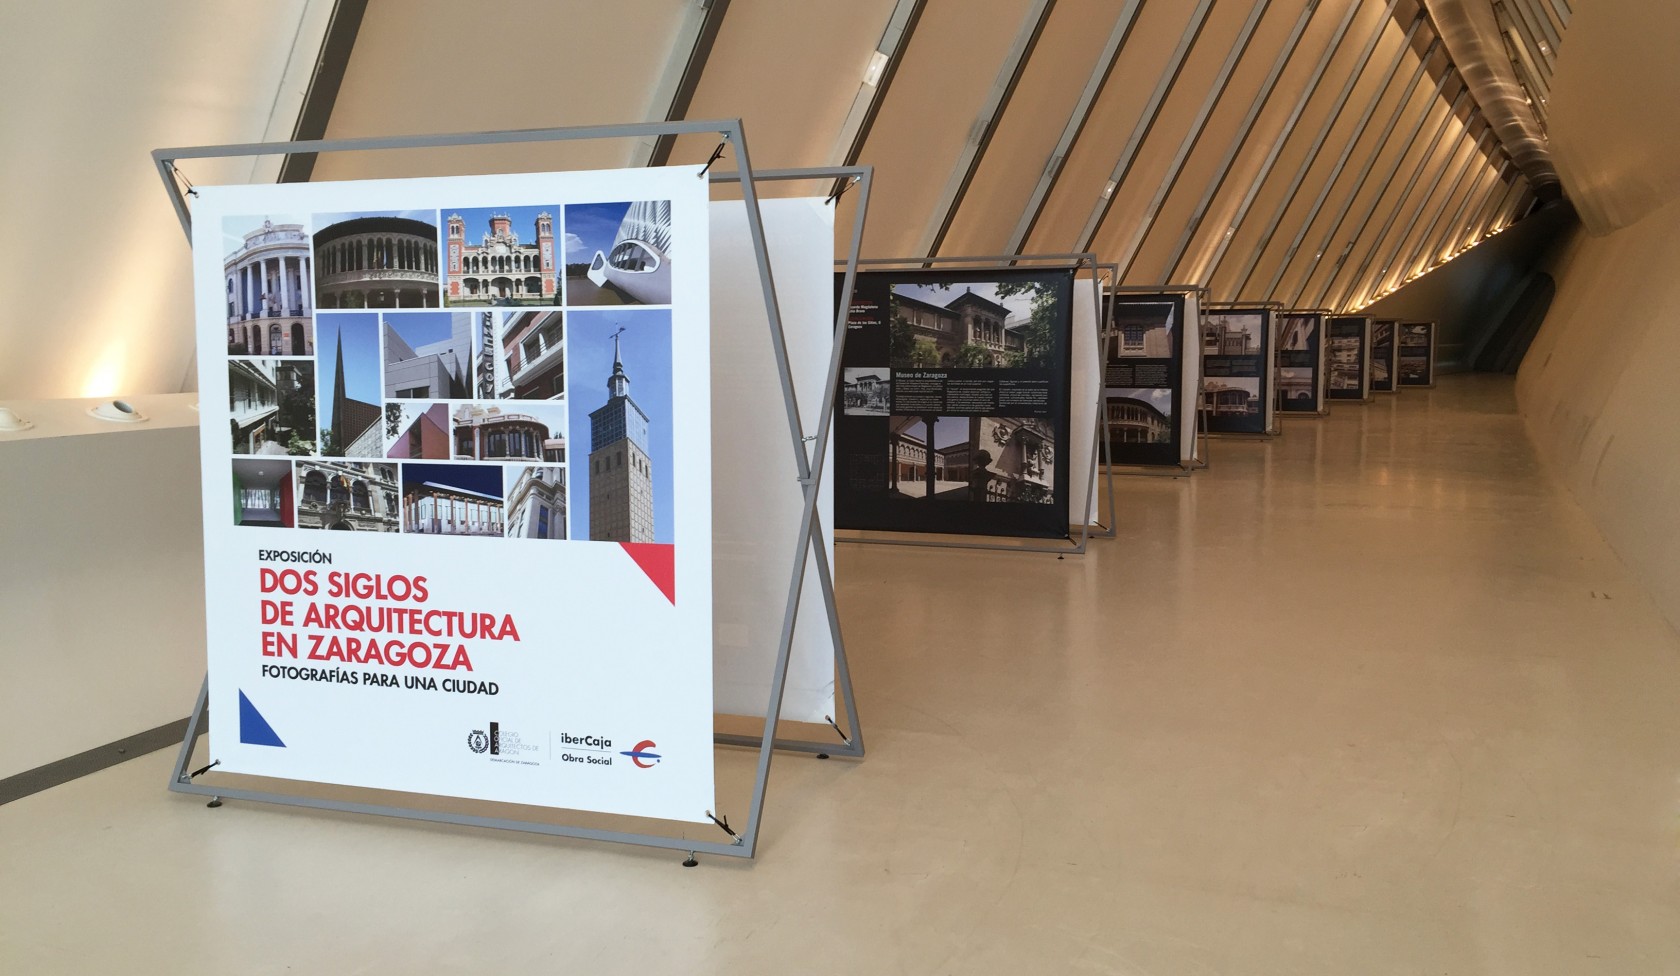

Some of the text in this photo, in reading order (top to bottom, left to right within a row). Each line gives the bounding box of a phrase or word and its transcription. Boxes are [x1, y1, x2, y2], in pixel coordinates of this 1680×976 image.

[258, 549, 332, 565] EXPOSICIÓN
[260, 568, 429, 603] DOS SIGLOS
[261, 600, 521, 642] DE ARQUITECTURA
[261, 632, 474, 672] EN ZARAGOZA
[262, 664, 499, 696] FOTOGRAFÍAS PARA UNA CIUDAD
[561, 732, 612, 749] iberCaja
[561, 753, 612, 766] Obra Social
